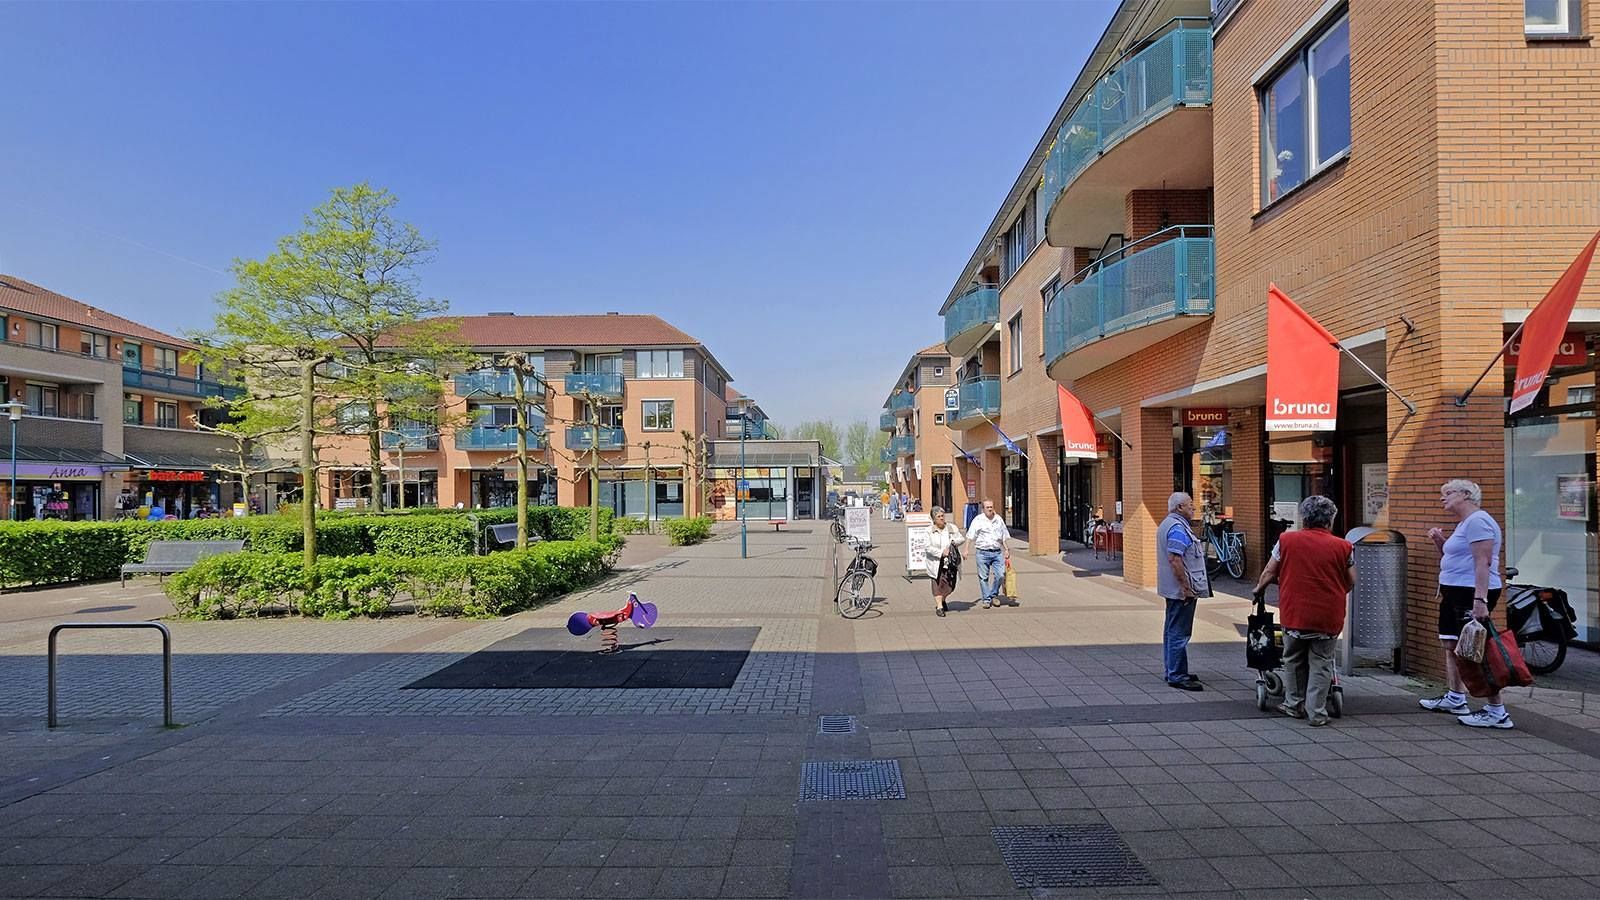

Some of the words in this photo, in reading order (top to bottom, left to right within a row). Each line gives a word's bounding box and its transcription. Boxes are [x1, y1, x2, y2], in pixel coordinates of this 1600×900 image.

[1273, 398, 1331, 415] bruna
[1187, 410, 1223, 421] bruna
[1068, 439, 1095, 450] bruna
[49, 467, 88, 479] Anna
